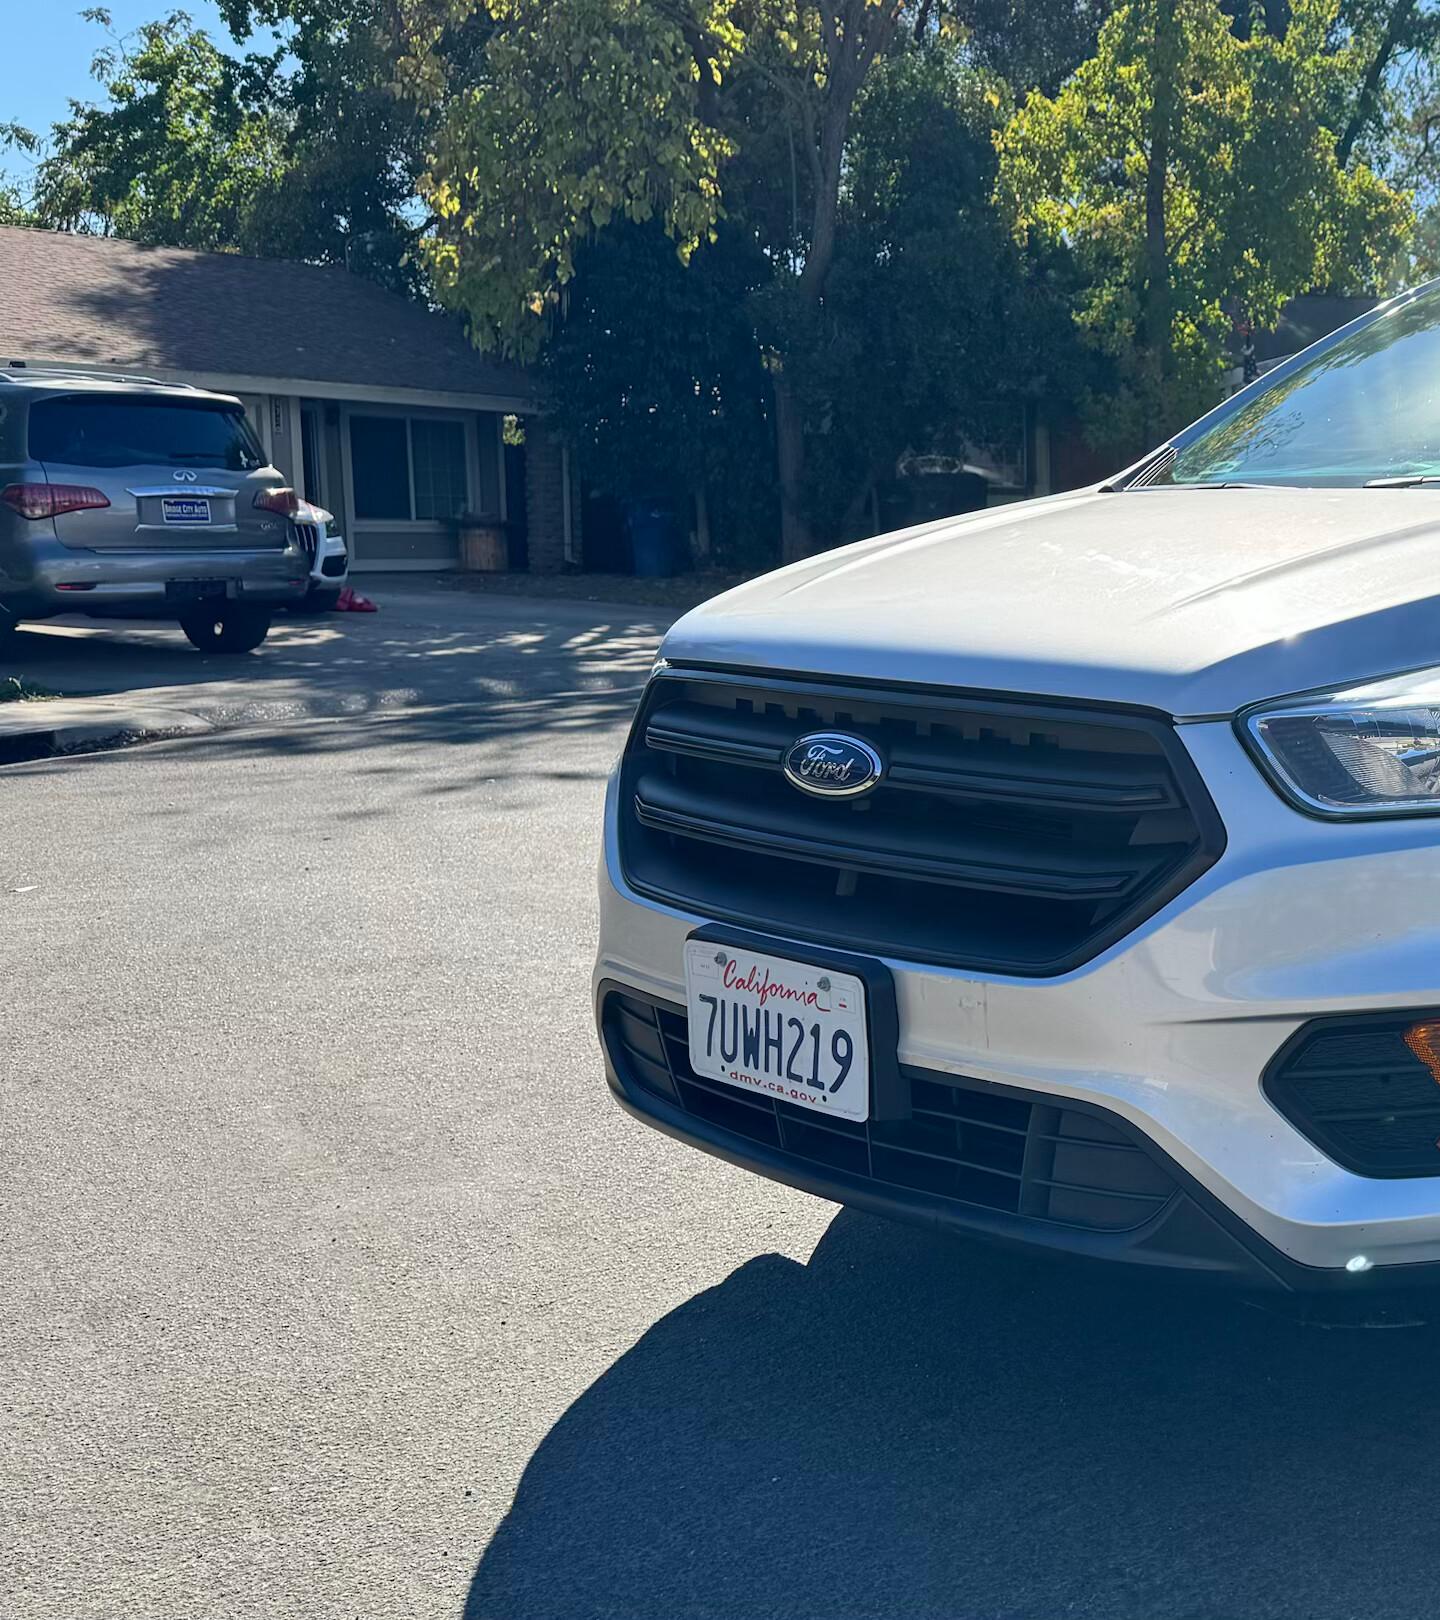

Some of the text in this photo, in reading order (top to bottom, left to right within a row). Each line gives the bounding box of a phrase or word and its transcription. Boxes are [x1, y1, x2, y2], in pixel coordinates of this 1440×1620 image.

[800, 744, 854, 781] Ford
[723, 960, 831, 1012] California
[699, 994, 853, 1094] 7UWH219
[729, 1070, 817, 1103] dmv.ca.gov
